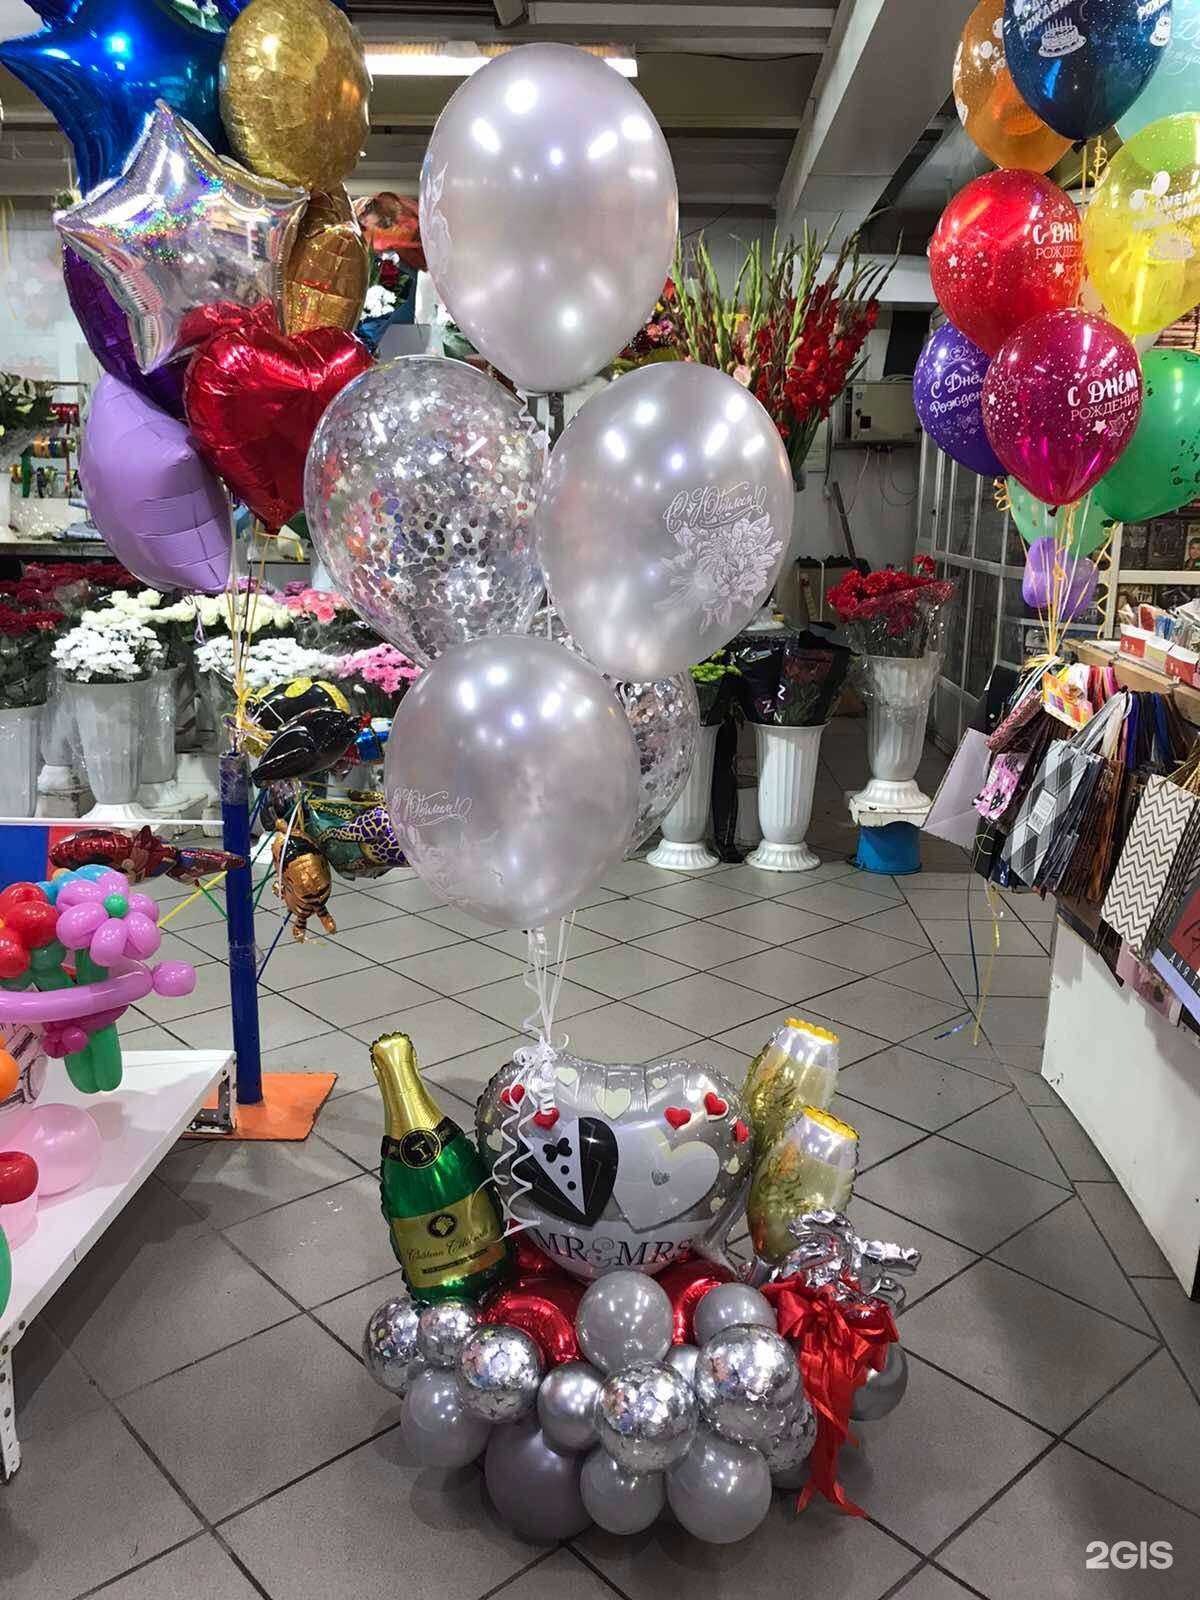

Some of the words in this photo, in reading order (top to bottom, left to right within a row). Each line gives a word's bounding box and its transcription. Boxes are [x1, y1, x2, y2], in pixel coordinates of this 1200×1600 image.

[930, 380, 943, 399] С
[1067, 386, 1080, 407] С
[1070, 389, 1140, 421] РОЖДЕНИЯ
